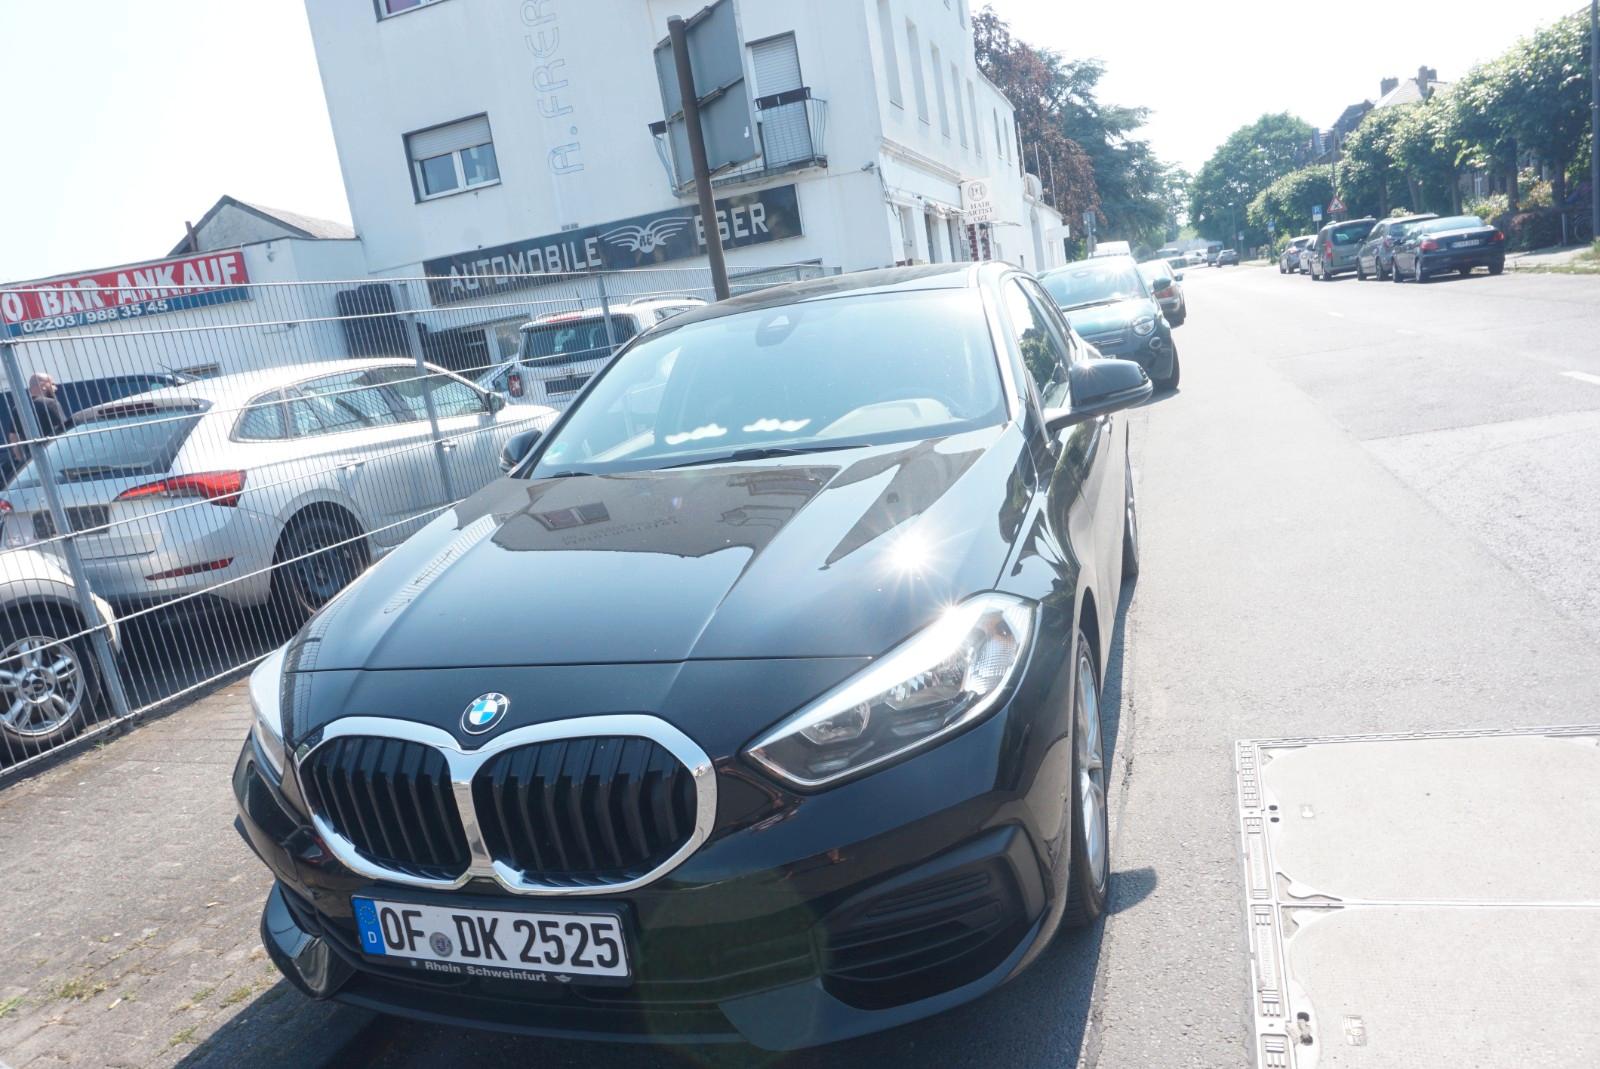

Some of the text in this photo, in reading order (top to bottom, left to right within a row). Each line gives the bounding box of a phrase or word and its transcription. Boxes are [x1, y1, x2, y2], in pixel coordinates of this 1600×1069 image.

[449, 236, 602, 294] AUTOMOBILE
[37, 255, 239, 317] BAR-ANKAUF
[120, 303, 142, 318] 35
[147, 299, 169, 313] 45
[367, 930, 377, 944] D
[380, 907, 620, 969] OF DK 2525
[424, 961, 548, 982] Rhein Schweinfurt
